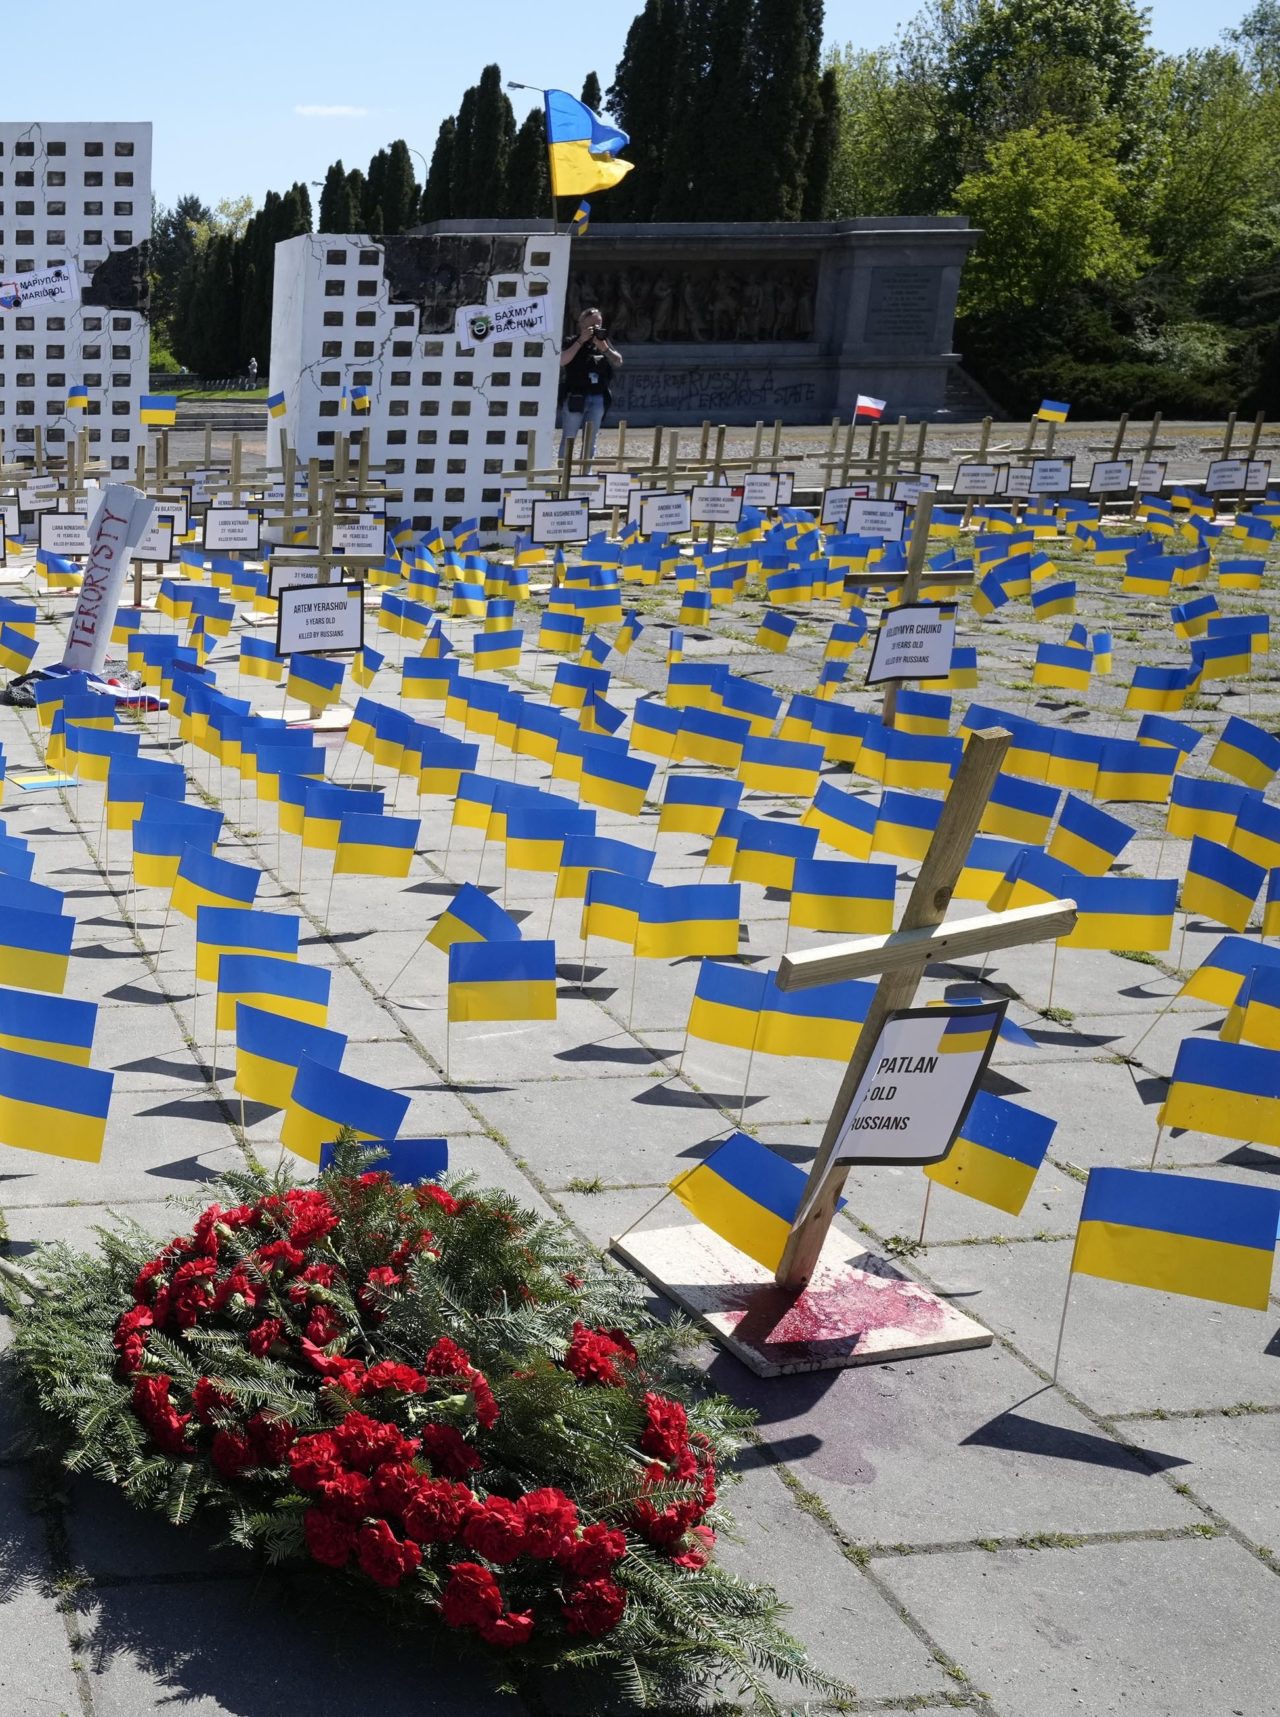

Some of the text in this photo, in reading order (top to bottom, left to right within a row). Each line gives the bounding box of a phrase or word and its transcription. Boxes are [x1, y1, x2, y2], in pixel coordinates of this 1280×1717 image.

[70, 509, 128, 649] TERORYSTY
[294, 602, 348, 614] ARTEM YERASHOV
[916, 624, 942, 634] CHUIKO
[877, 1056, 938, 1074] PATLAN
[870, 1086, 897, 1100] OLD
